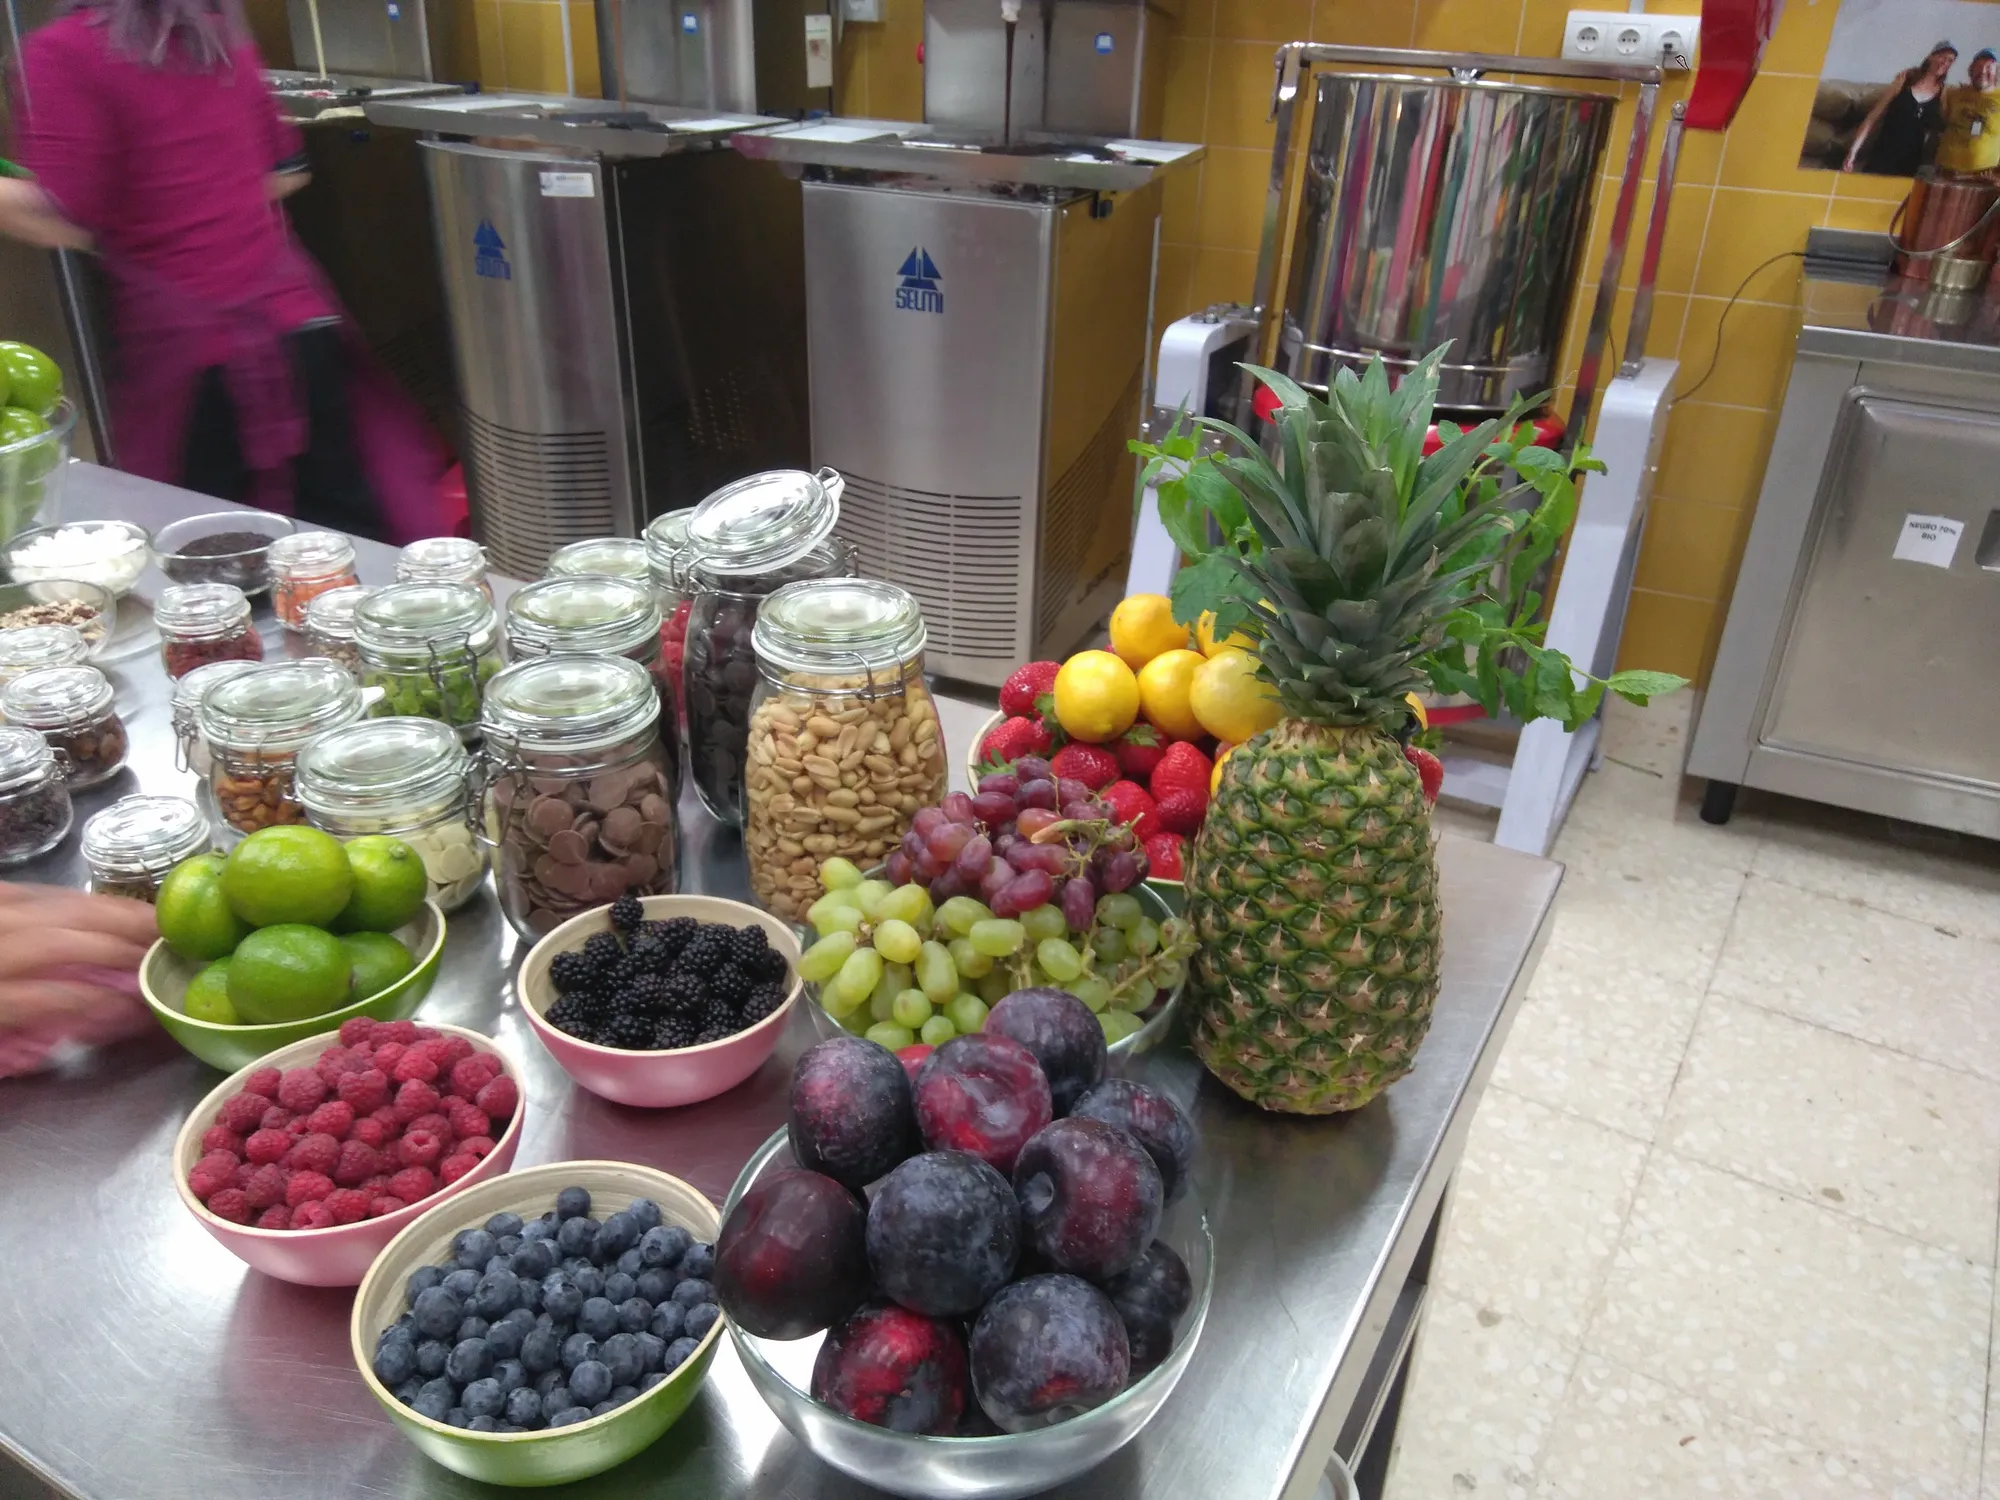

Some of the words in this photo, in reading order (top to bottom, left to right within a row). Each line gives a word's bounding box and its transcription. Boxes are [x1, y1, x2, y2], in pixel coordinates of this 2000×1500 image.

[895, 287, 943, 313] SELMI
[1909, 521, 1937, 531] NEGRO
[1921, 532, 1936, 541] BIO
